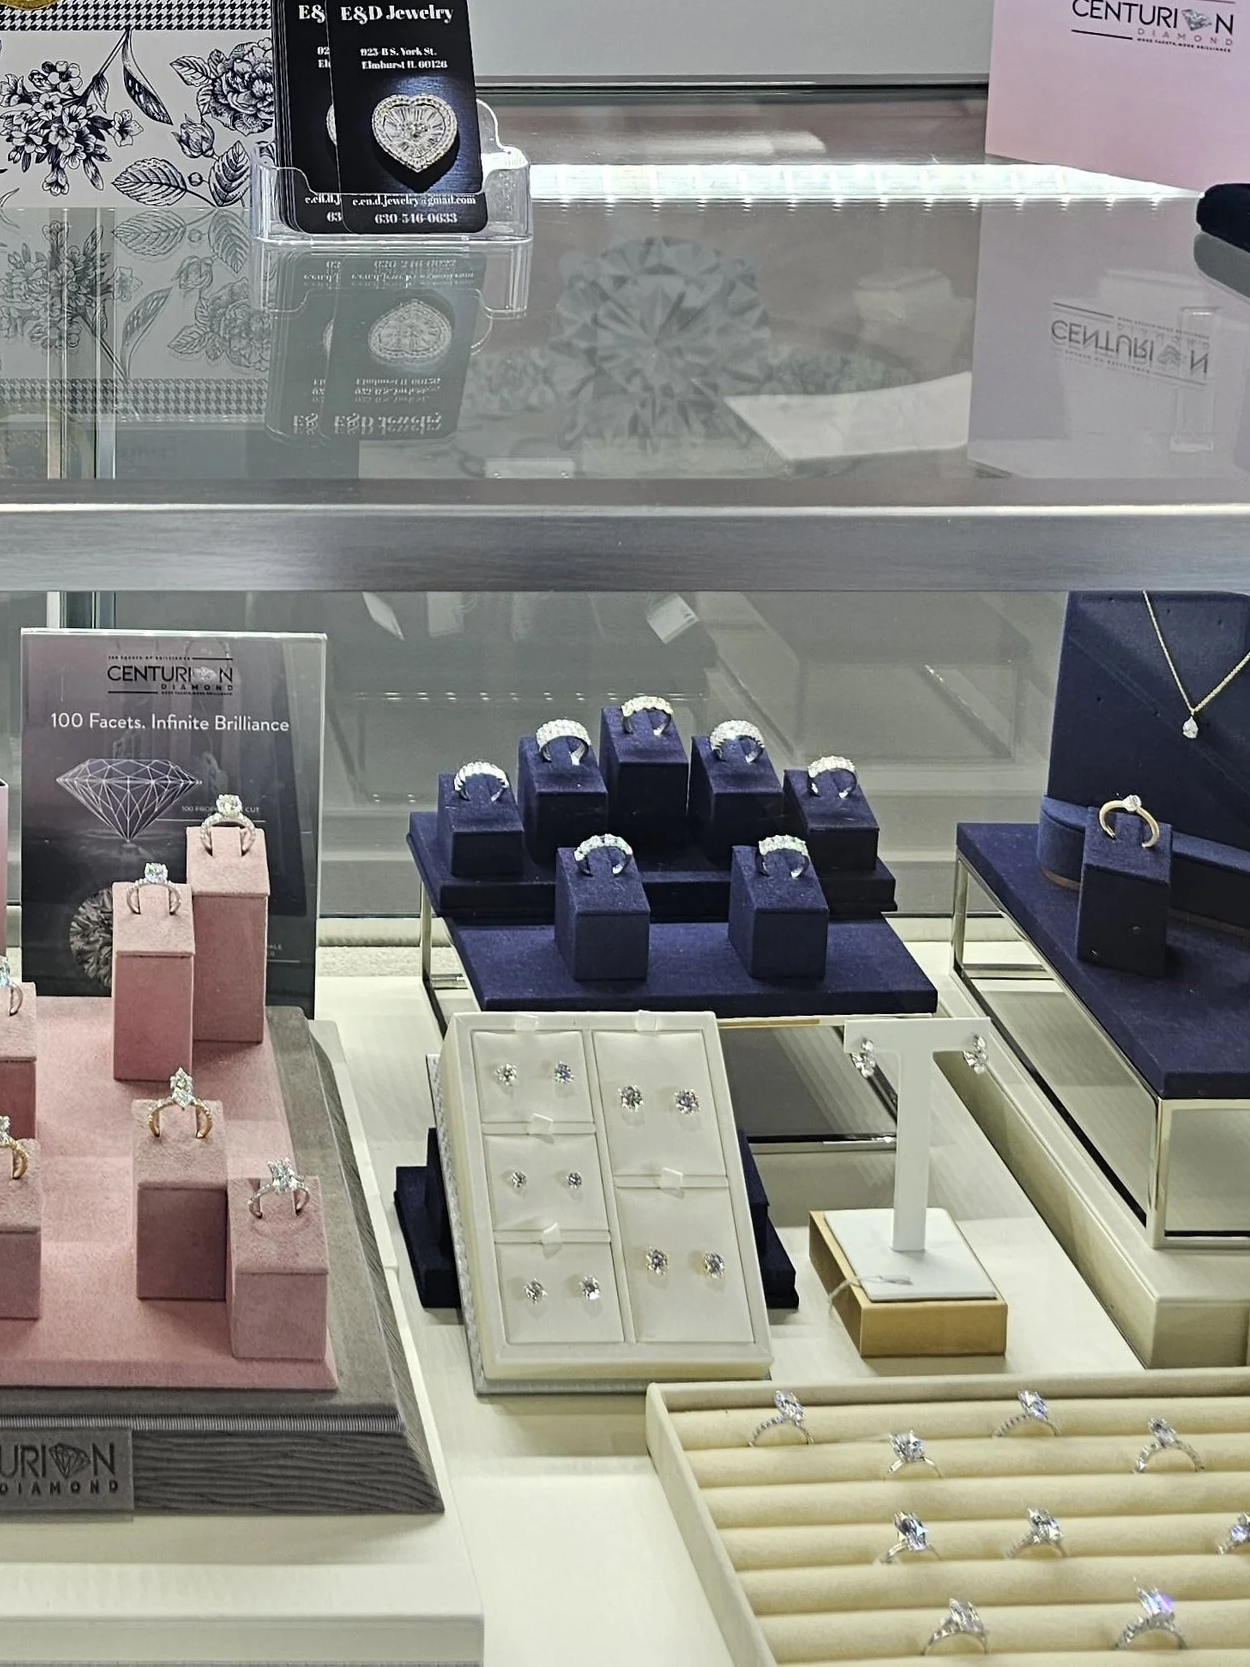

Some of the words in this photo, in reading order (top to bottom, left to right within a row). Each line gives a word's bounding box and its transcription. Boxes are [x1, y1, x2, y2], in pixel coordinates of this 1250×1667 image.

[340, 5, 384, 25] E&D
[385, 4, 454, 24] Jewelry
[1137, 27, 1233, 46] DIAMOND
[400, 46, 423, 56] York
[361, 60, 405, 70] Elmhurst
[50, 712, 84, 729] 100
[89, 713, 147, 729] Facets.
[151, 713, 210, 731] Infinite
[214, 714, 290, 732] Brilliance
[0, 1479, 119, 1496] DIAMOND
